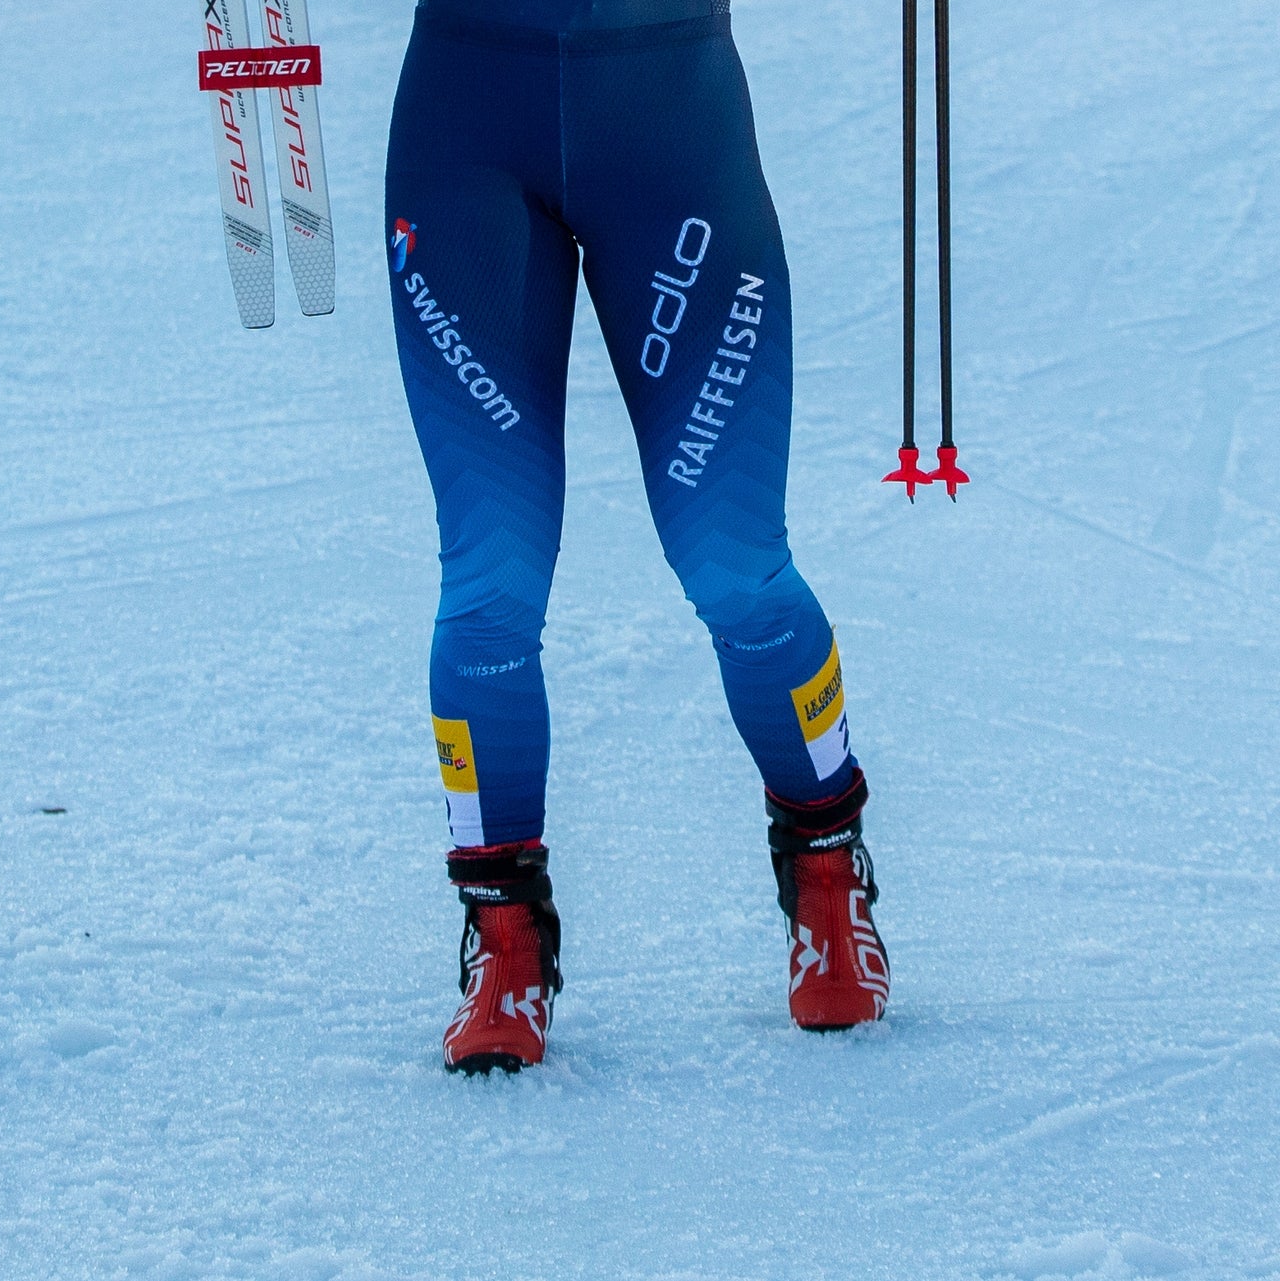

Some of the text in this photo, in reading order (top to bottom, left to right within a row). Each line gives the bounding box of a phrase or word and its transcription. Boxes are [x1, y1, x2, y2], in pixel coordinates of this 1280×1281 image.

[404, 271, 521, 433] swisscom
[640, 217, 712, 378] odlo
[667, 271, 765, 488] RAIFFEISEN
[734, 630, 796, 652] swisscom
[809, 828, 853, 849] alpina
